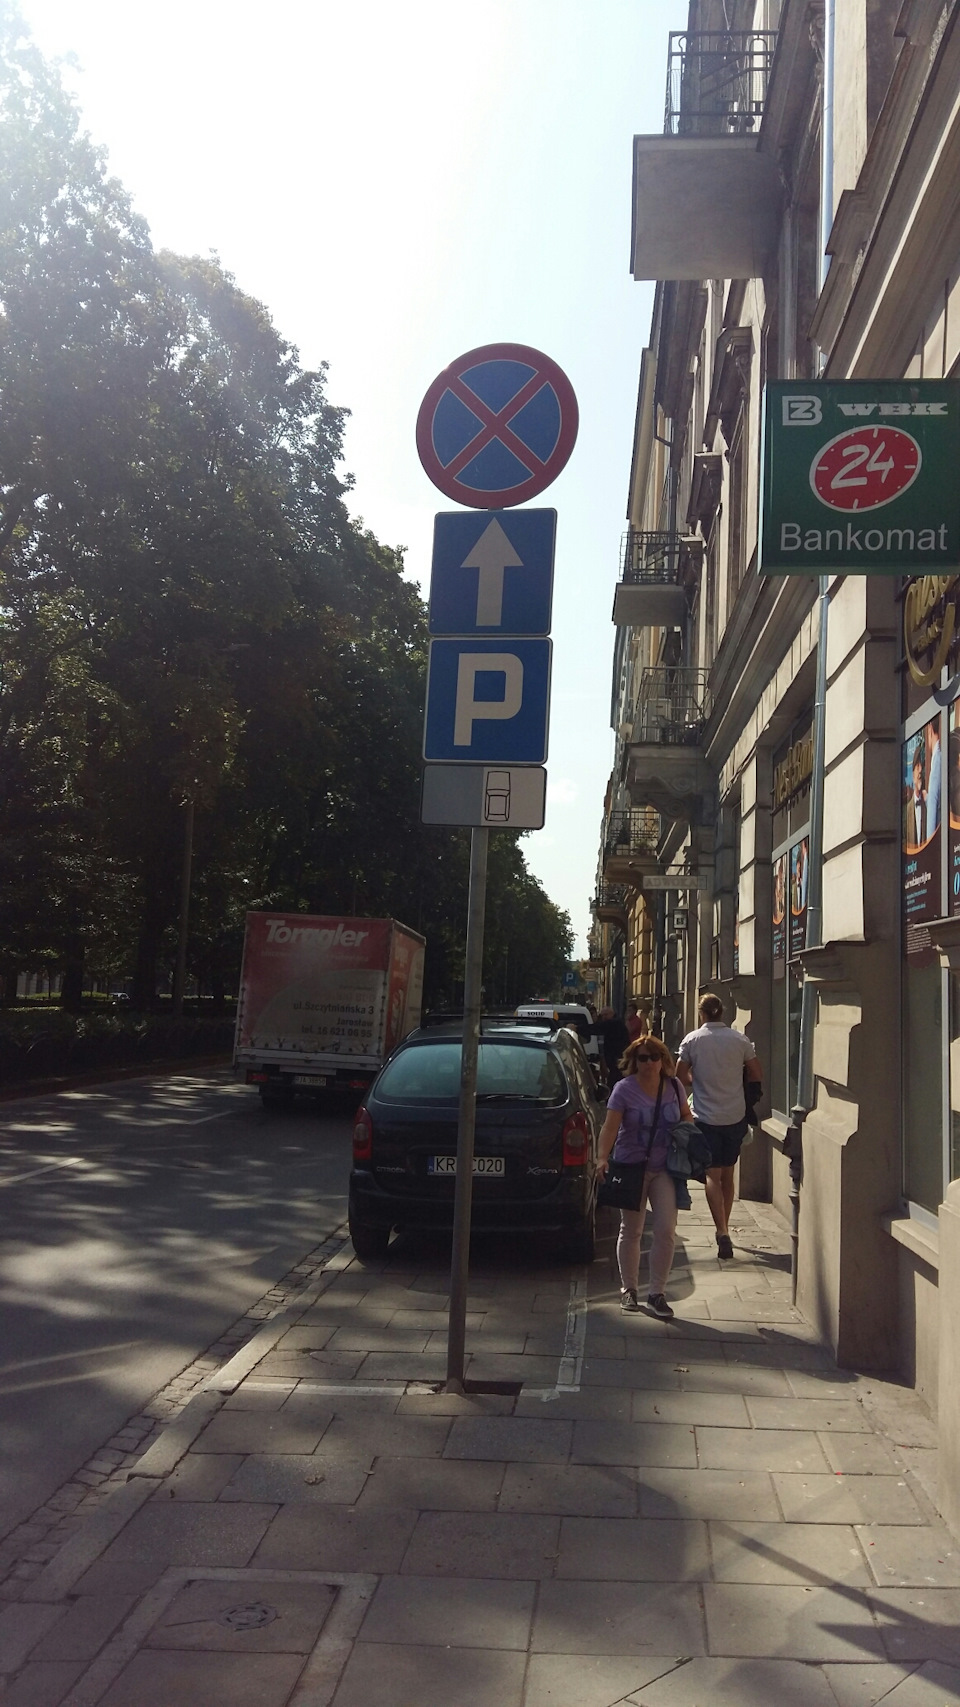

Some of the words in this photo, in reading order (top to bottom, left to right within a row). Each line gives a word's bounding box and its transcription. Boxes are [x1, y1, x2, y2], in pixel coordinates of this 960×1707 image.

[837, 402, 949, 416] WBK
[830, 441, 895, 490] 24
[780, 522, 948, 551] Bankomat
[453, 653, 524, 746] P
[565, 972, 574, 983] P
[368, 1005, 375, 1015] 3
